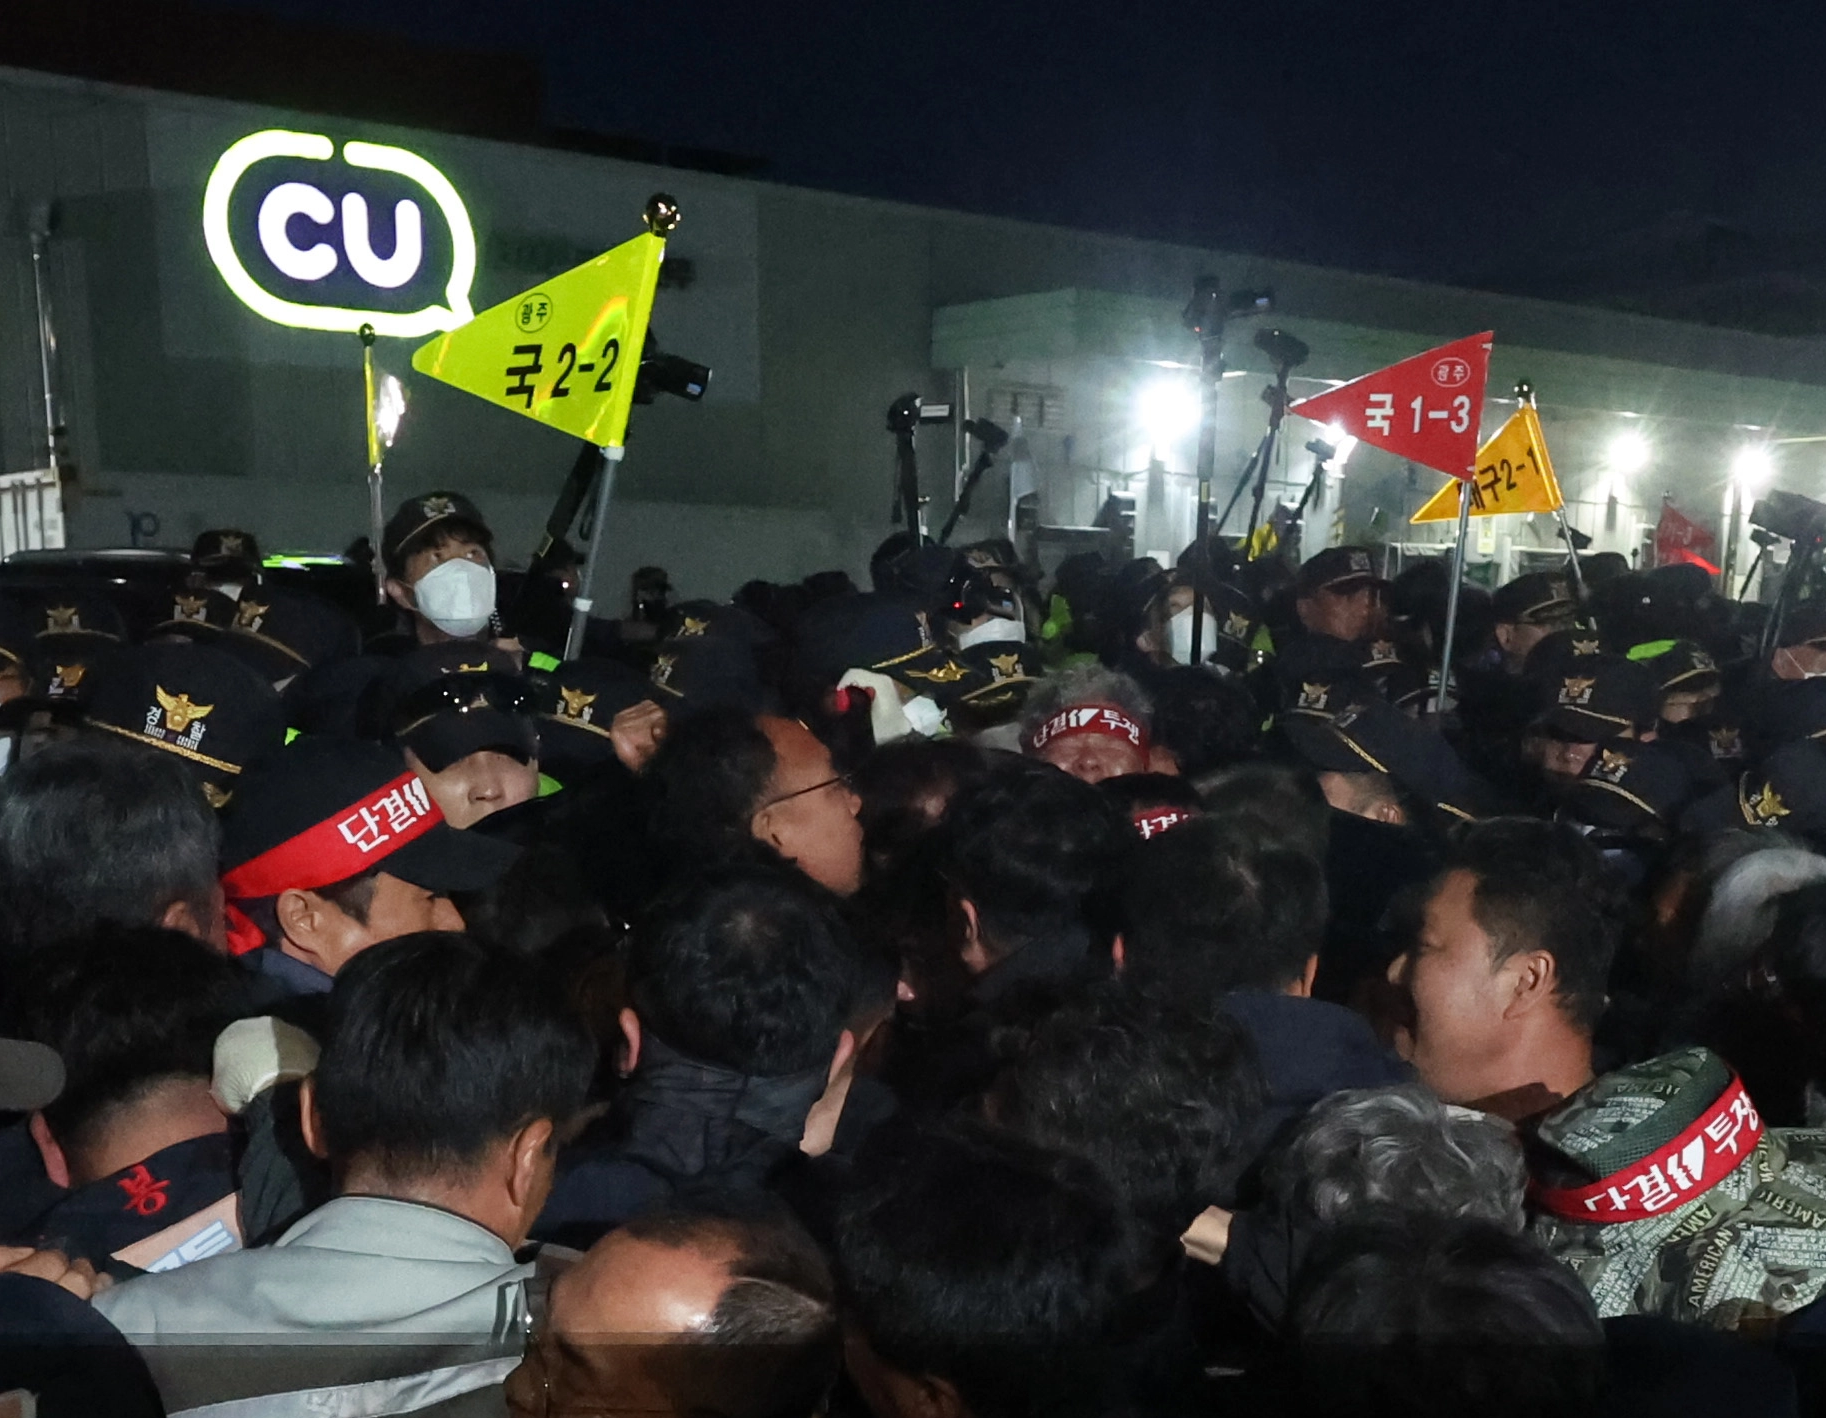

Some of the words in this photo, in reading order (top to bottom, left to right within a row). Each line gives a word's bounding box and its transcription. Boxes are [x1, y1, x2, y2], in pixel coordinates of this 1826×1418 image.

[258, 181, 422, 290] CU
[505, 344, 543, 409] 국
[551, 338, 619, 397] 2-2
[1365, 393, 1395, 436] 국
[1410, 395, 1471, 433] 1-3
[1100, 709, 1140, 746] 투쟁
[337, 786, 418, 853] 단결
[1688, 1226, 1735, 1309] AMERICAN
